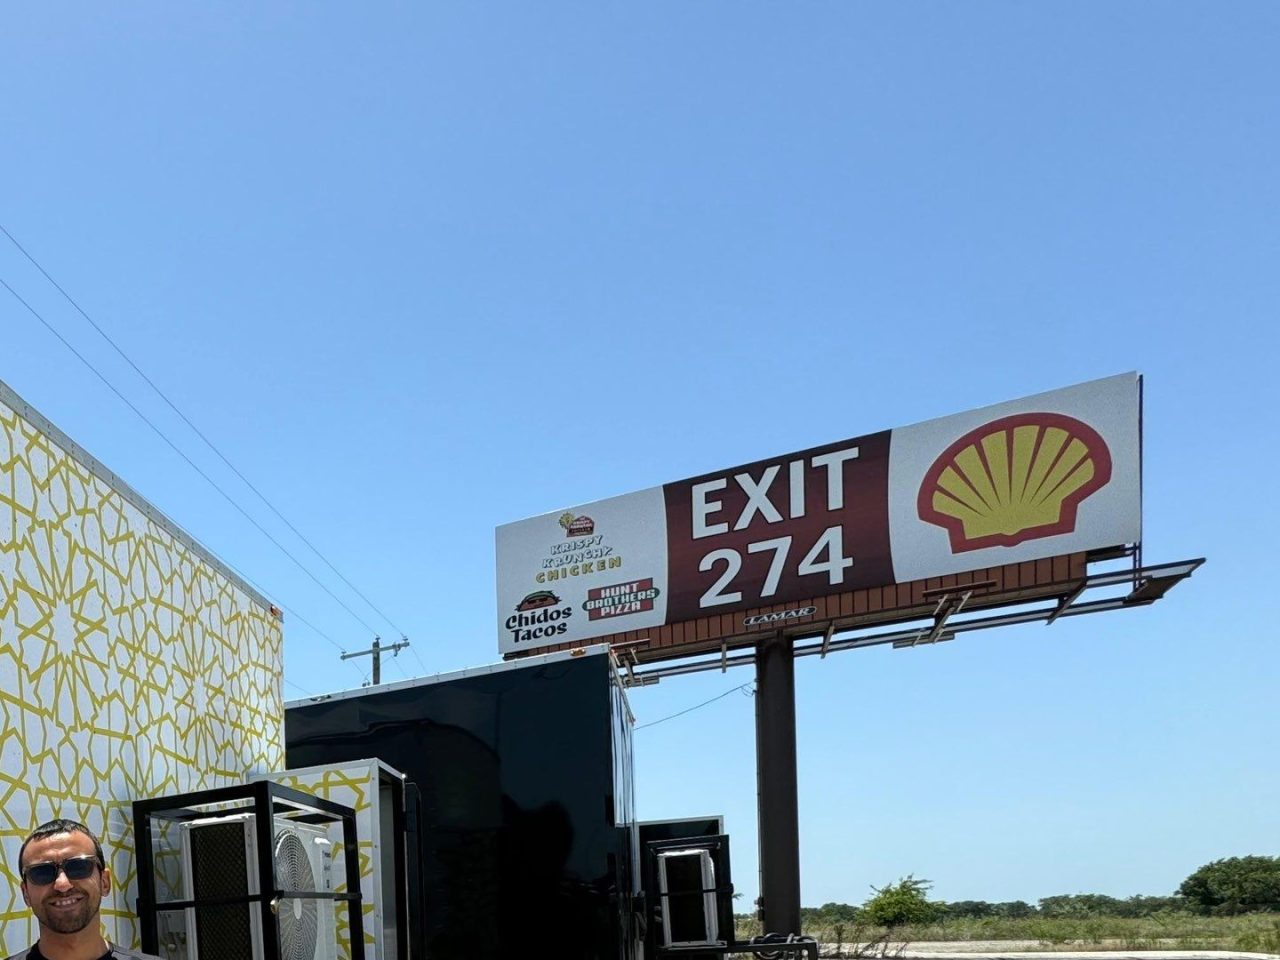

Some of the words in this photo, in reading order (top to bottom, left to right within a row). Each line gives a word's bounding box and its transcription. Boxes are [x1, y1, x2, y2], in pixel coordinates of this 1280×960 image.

[691, 446, 860, 540] EXIT
[550, 535, 604, 556] KRISPY
[542, 546, 613, 569] KRUNCHY
[698, 525, 854, 609] 274
[535, 556, 622, 584] CHICKEN
[585, 589, 656, 610] BROTHERS
[600, 582, 640, 599] HUNT
[505, 606, 572, 630] Chidos
[600, 601, 641, 617] PIZZA
[749, 608, 810, 625] LAMAR
[510, 622, 567, 643] Tacos
